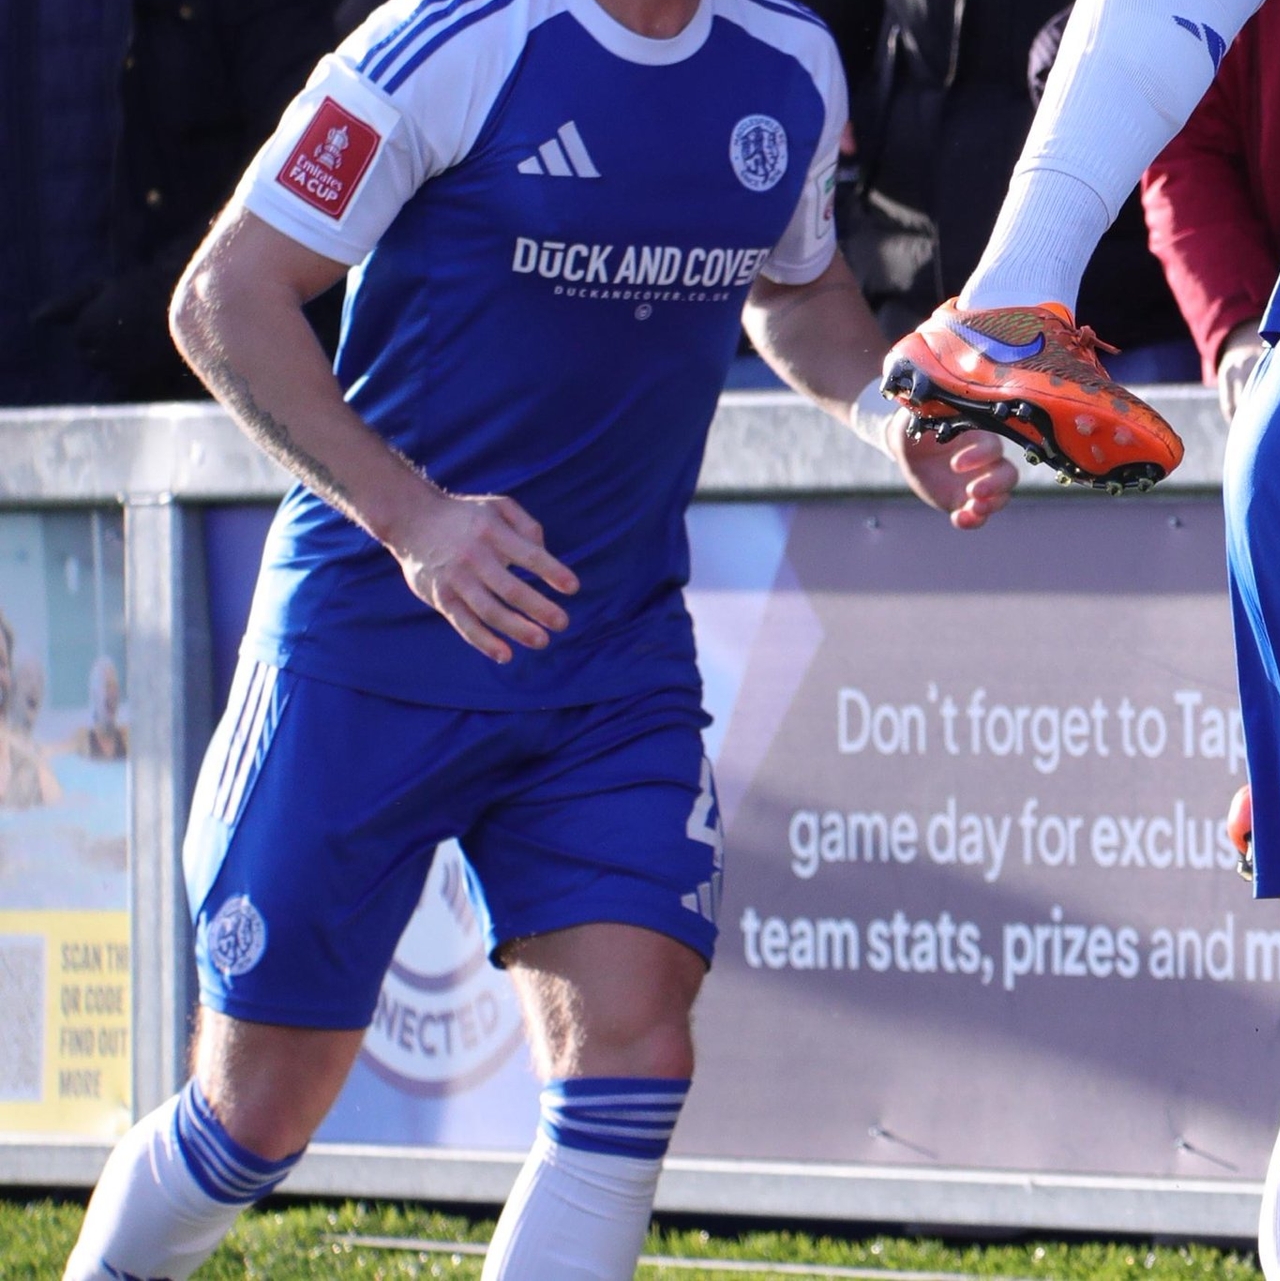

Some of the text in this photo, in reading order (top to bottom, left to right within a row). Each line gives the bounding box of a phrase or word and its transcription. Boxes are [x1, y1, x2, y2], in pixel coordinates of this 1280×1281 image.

[289, 166, 339, 201] FA CUP
[297, 154, 343, 191] Emirates
[613, 245, 682, 285] AND
[837, 681, 960, 756] Don't
[967, 688, 1109, 774] forget
[1118, 696, 1168, 758] to
[789, 803, 917, 879] game
[926, 796, 1012, 883] day
[1017, 796, 1083, 868] for
[61, 942, 102, 972] SCAN
[742, 907, 860, 971] team
[866, 910, 994, 985] stats,
[1002, 905, 1140, 992] prizes
[1149, 912, 1235, 982] and
[61, 984, 123, 1018] QR CODE
[60, 1026, 127, 1057] FIND OUT
[58, 1069, 101, 1099] MORE
